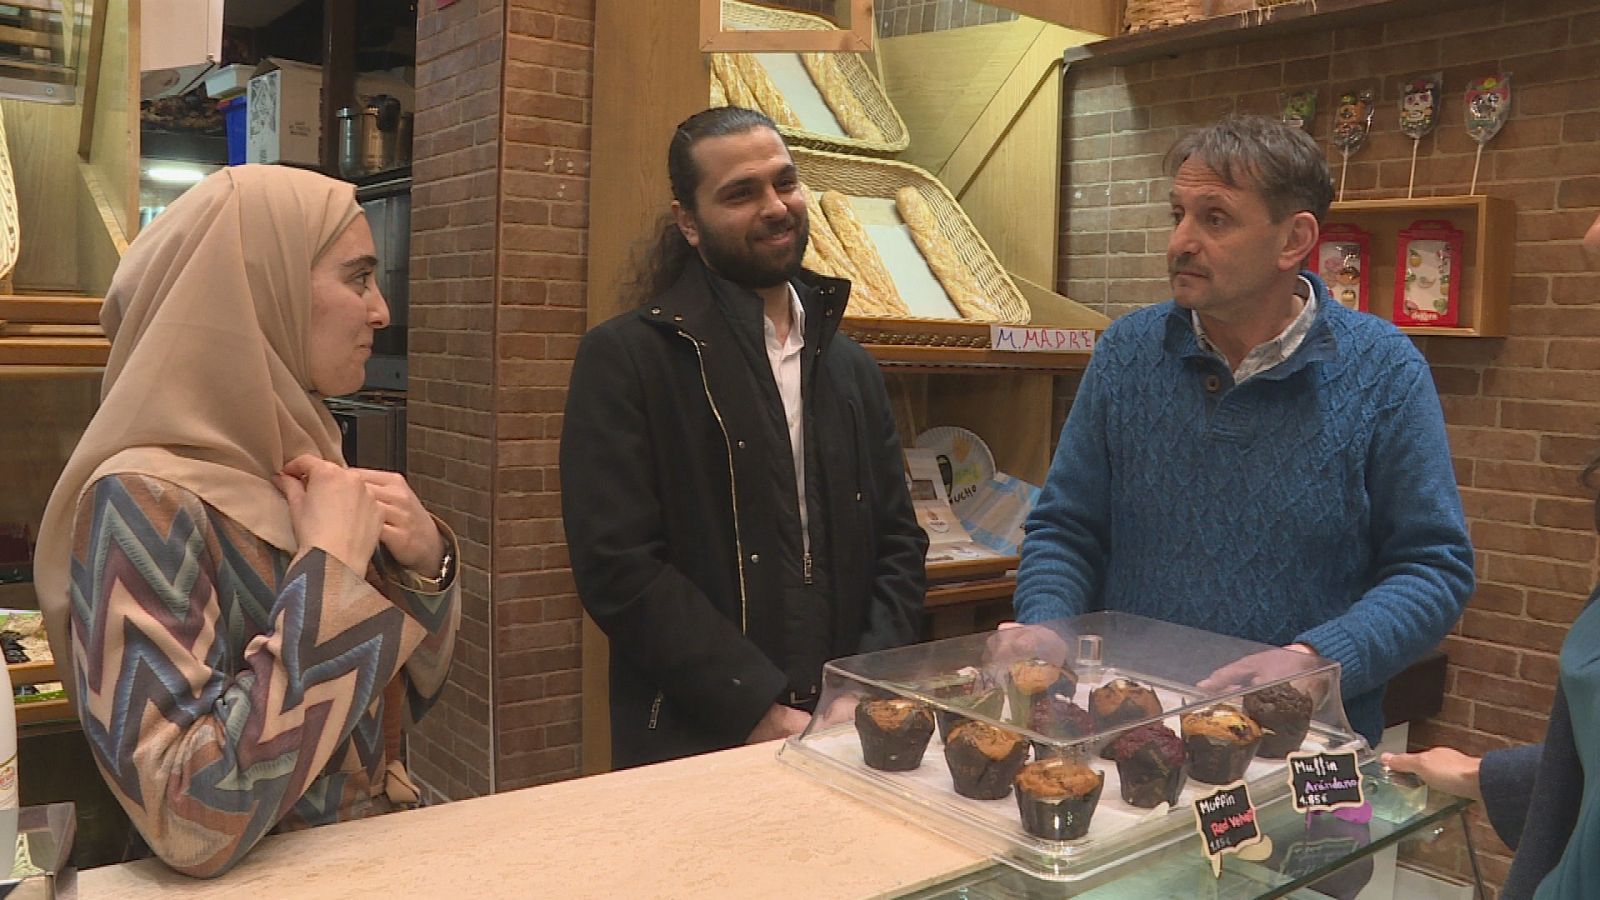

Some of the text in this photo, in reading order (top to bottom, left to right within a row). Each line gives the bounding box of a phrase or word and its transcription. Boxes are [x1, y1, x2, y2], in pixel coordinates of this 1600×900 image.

[1023, 329, 1093, 349] MADRE
[1293, 756, 1339, 776] Muffin
[1199, 793, 1236, 814] Muffin
[1211, 816, 1229, 837] Red
